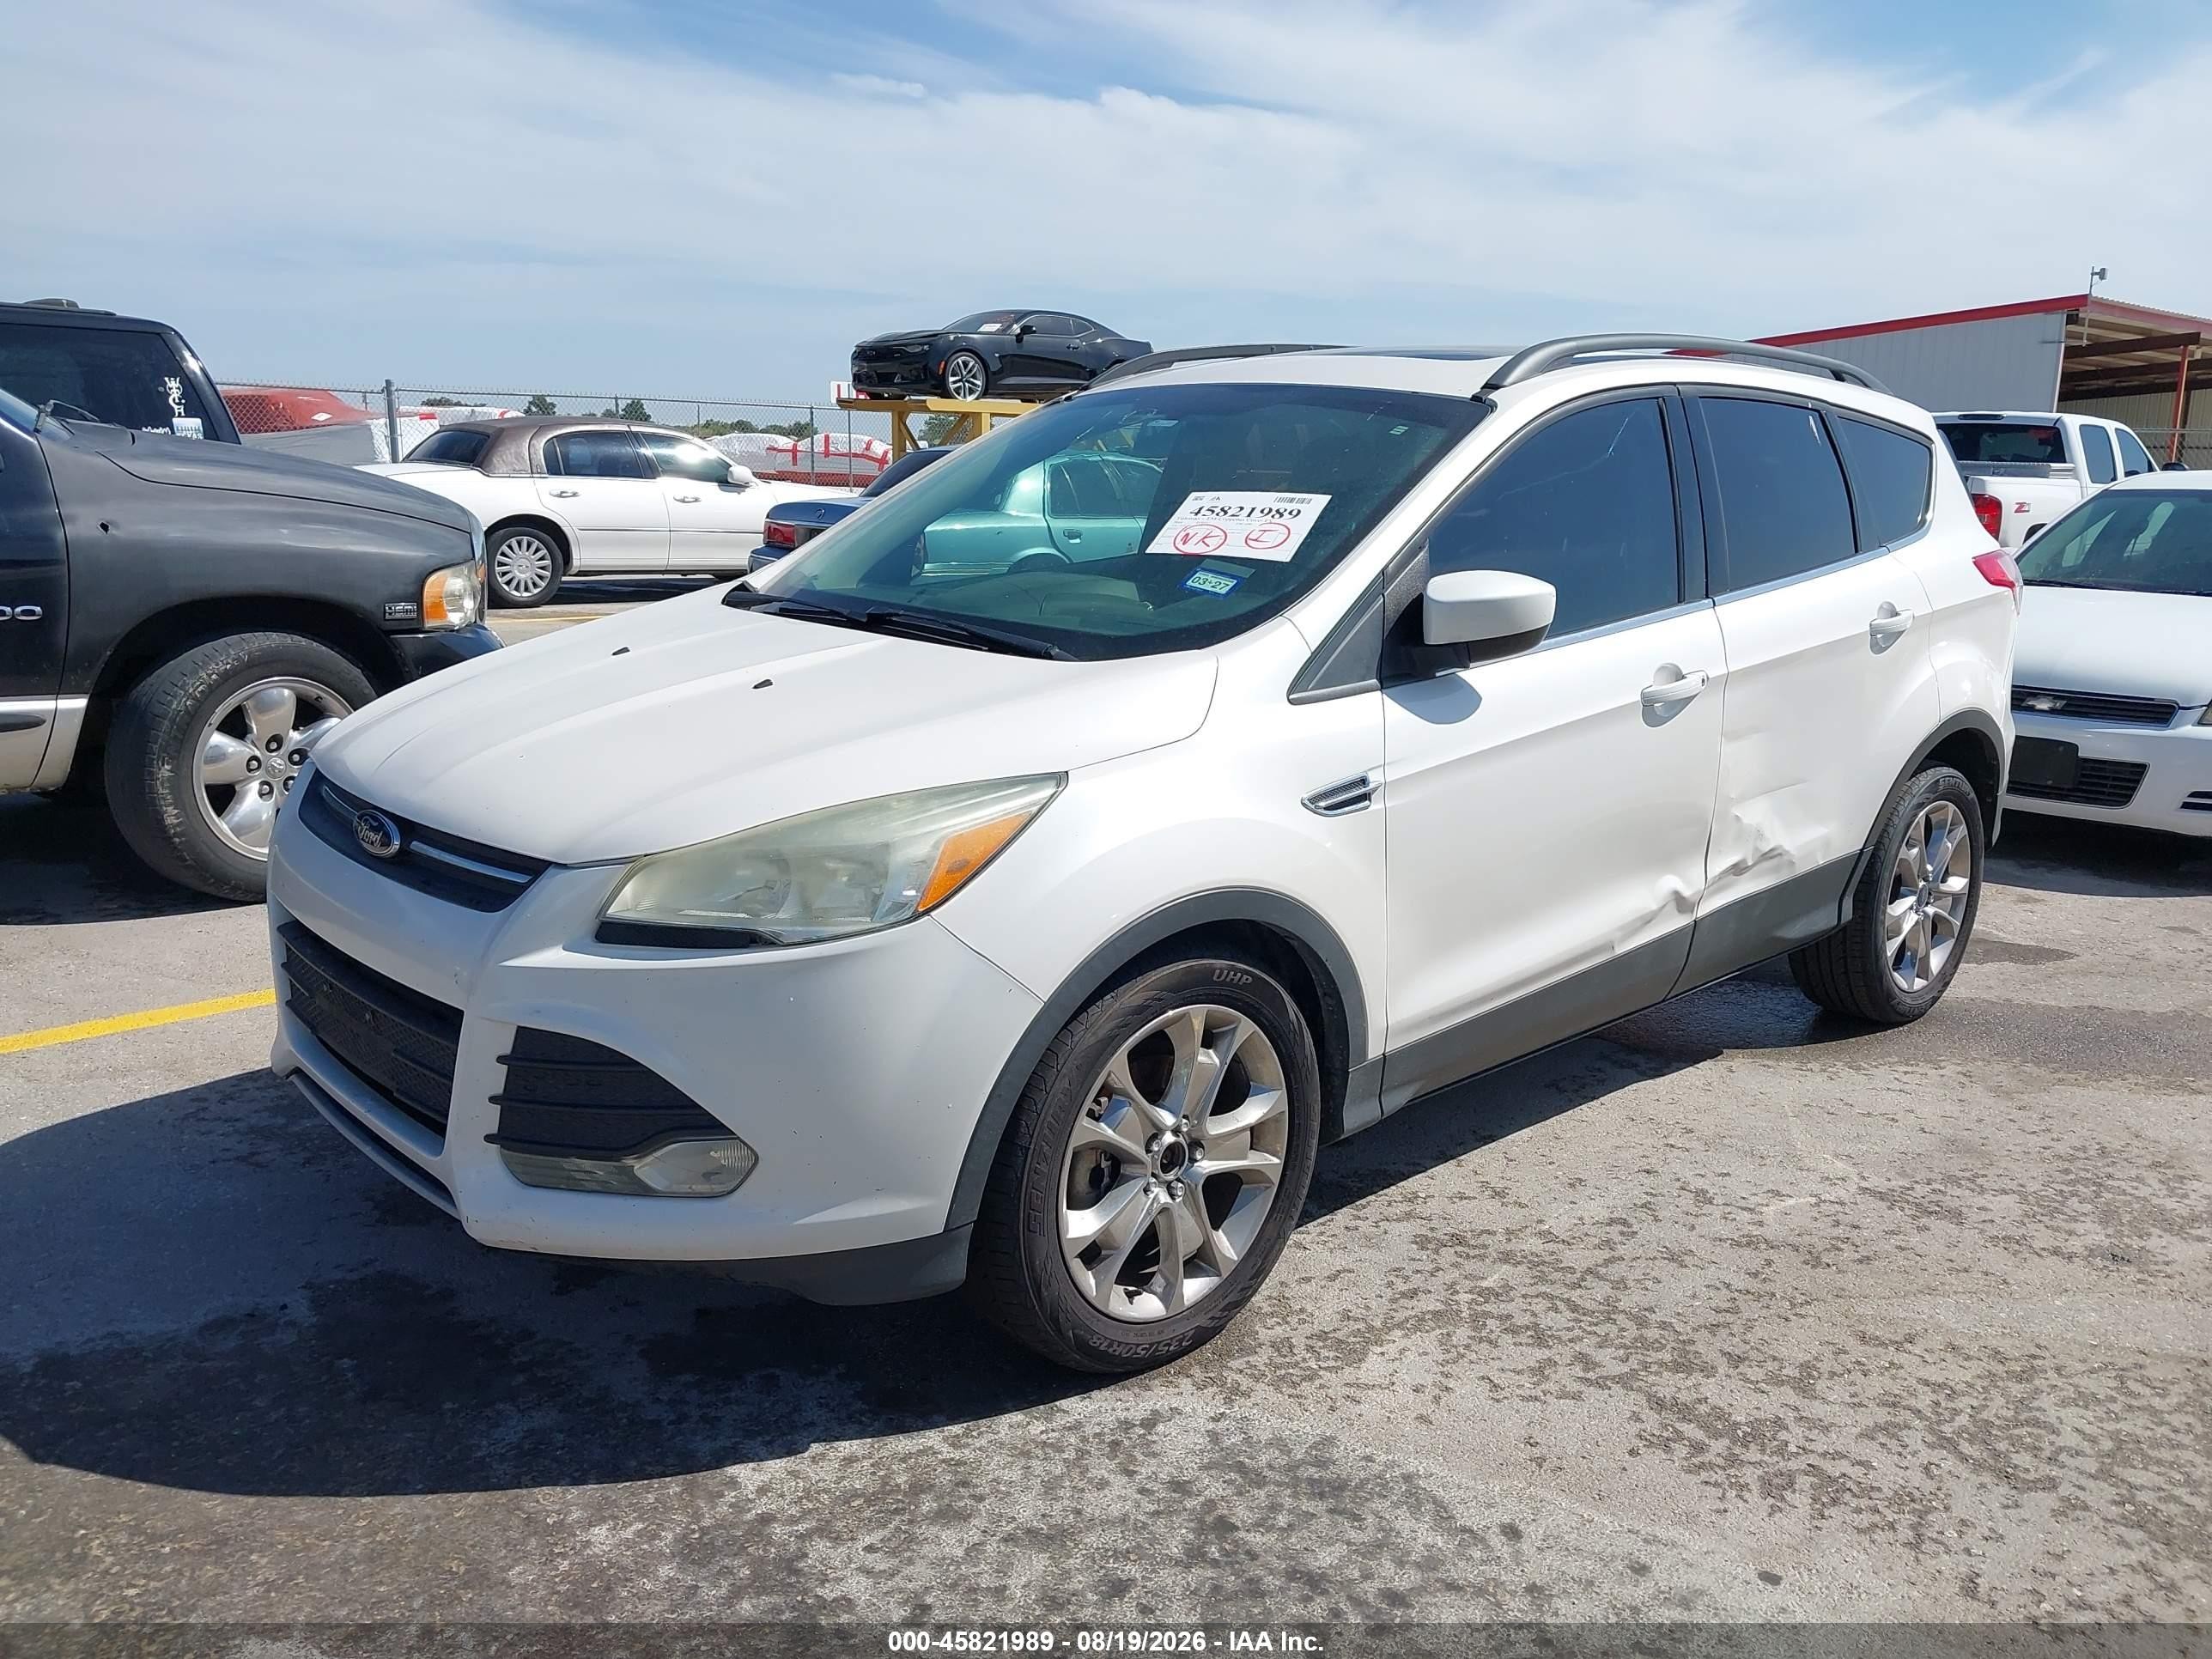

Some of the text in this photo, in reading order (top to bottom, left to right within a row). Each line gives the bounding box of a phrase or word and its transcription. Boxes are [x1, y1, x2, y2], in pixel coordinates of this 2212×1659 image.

[1189, 505, 1302, 520] 45821989
[357, 816, 383, 848] Ford
[1212, 969, 1253, 985] UHP
